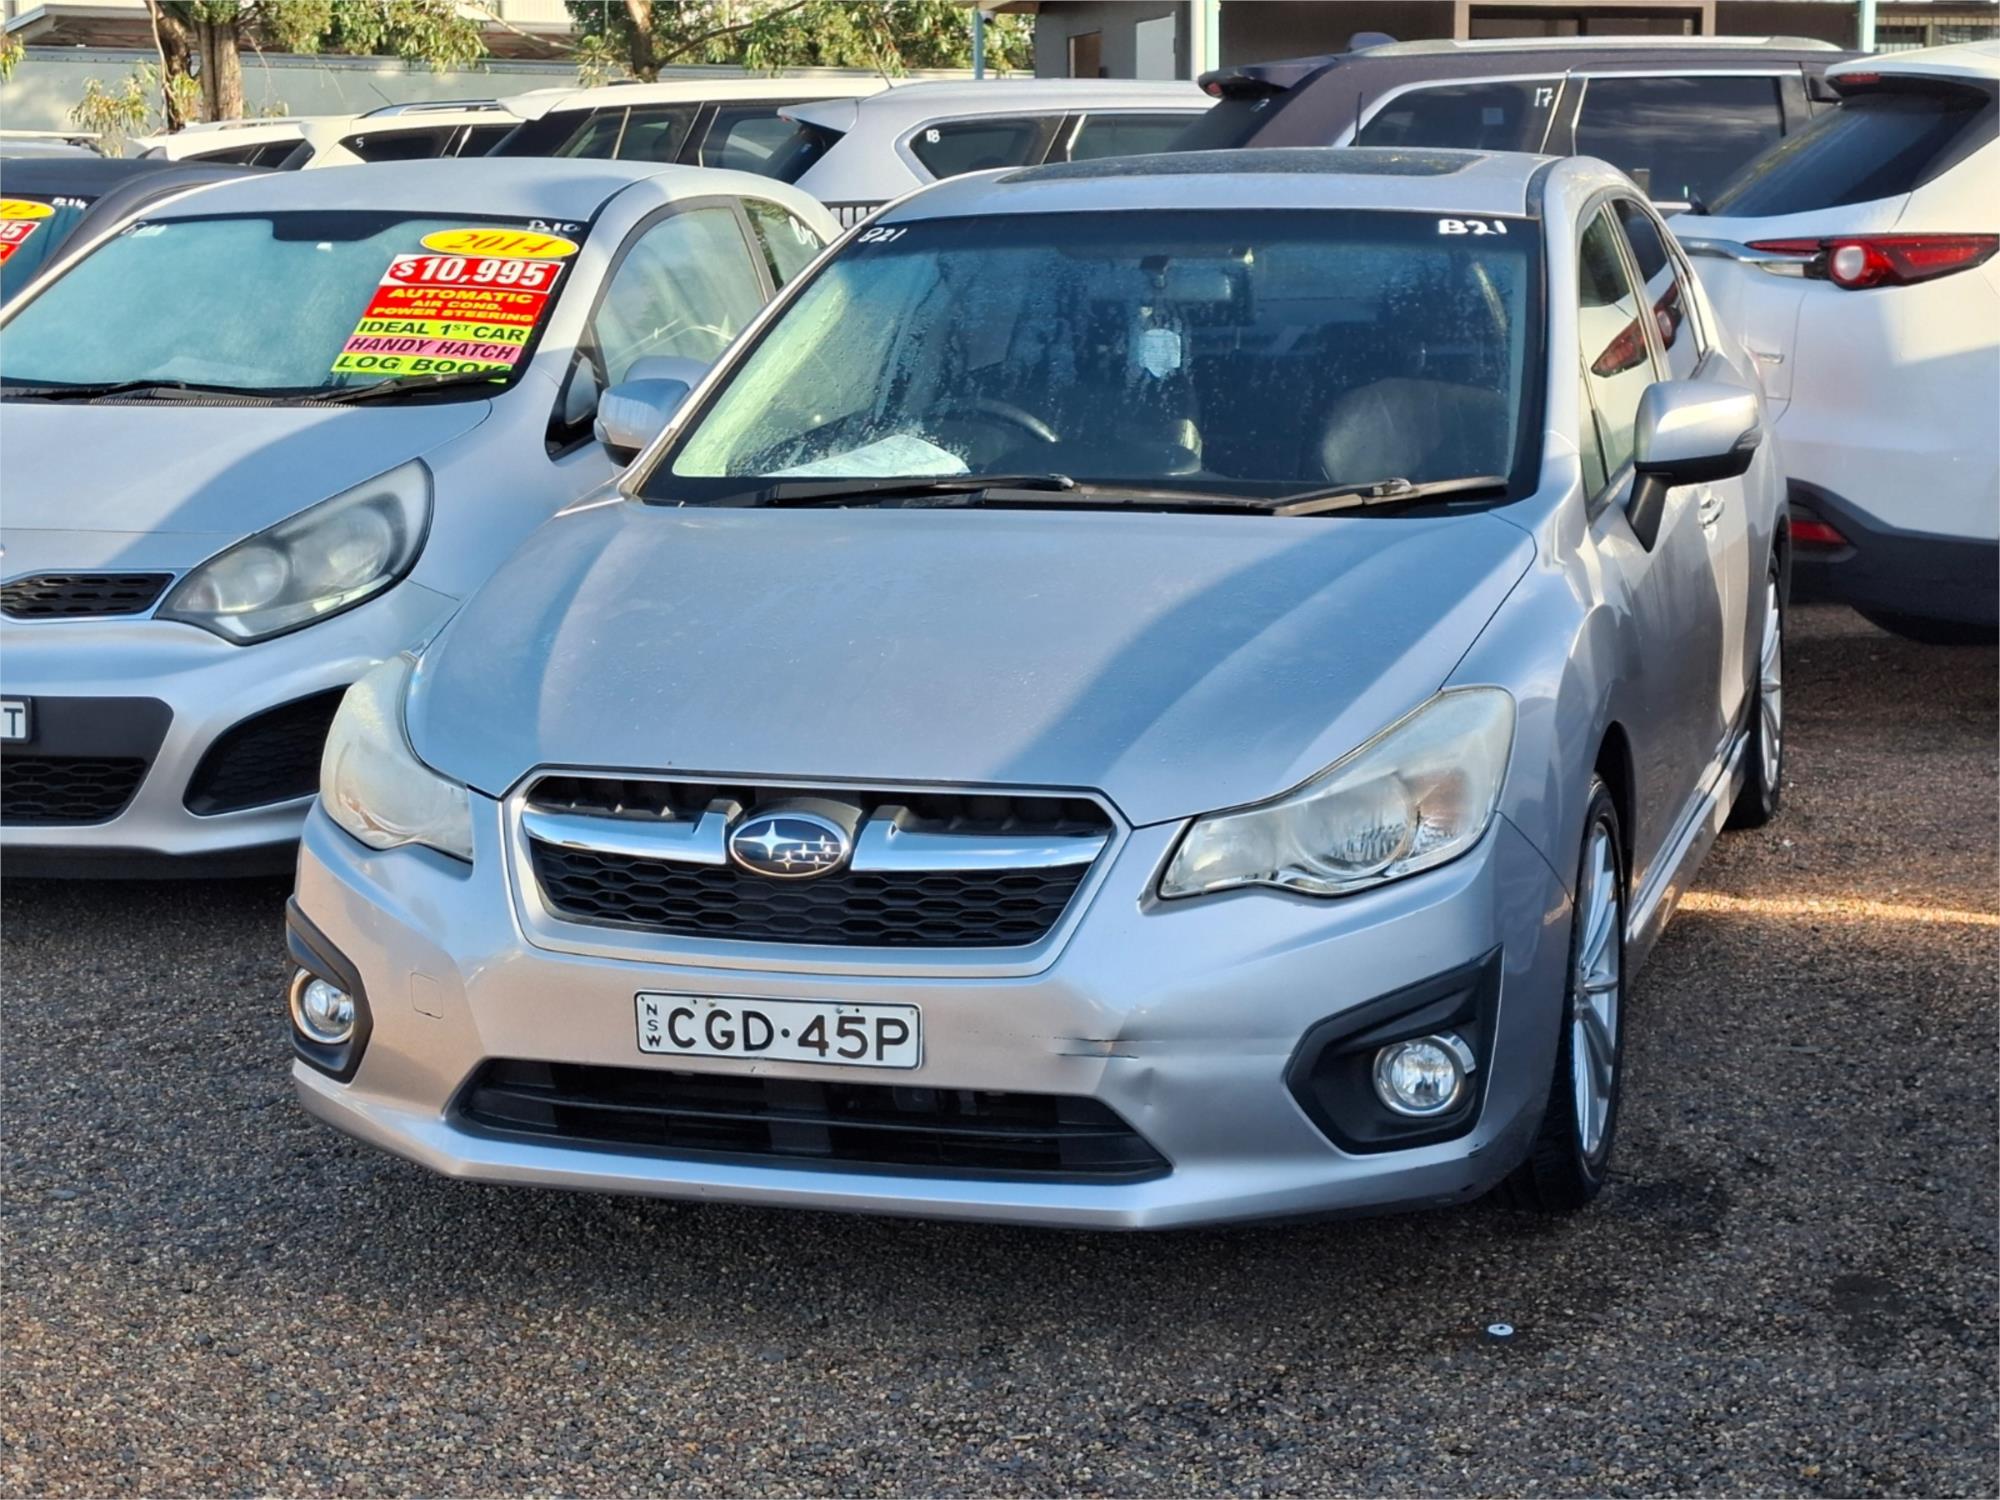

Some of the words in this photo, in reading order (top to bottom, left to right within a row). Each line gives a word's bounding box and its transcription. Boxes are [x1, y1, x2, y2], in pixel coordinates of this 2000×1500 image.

[1534, 87, 1553, 107] 17
[1438, 219, 1507, 235] B21
[446, 233, 557, 254] 2014
[388, 289, 534, 304] AUTOMATIC
[411, 300, 443, 309] AIR
[447, 301, 503, 311] COND.
[372, 307, 438, 317] POWER
[441, 309, 534, 322] STEERING
[358, 320, 430, 335] IDEAL
[472, 326, 526, 342] CAR
[348, 337, 434, 352] HANDY
[435, 340, 517, 360] HATCH
[336, 355, 402, 370] LOG
[645, 1004, 662, 1047] NSW
